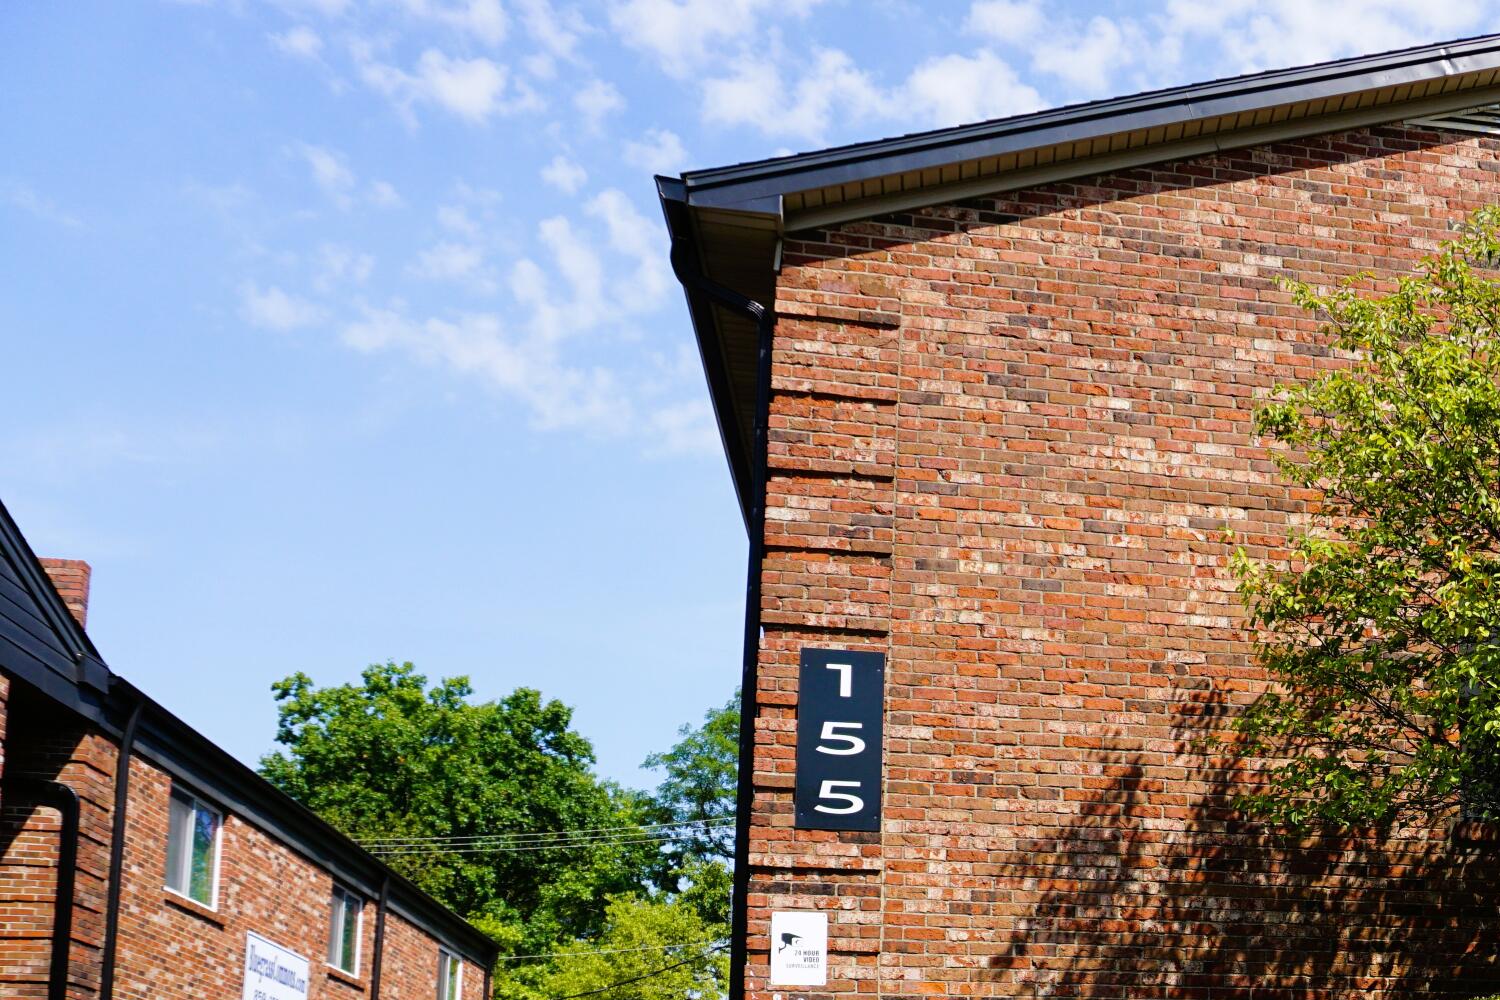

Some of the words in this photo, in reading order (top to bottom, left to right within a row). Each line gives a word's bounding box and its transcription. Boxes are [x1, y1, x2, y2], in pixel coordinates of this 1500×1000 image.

[814, 663, 866, 815] 155
[794, 949, 802, 957] 24
[803, 949, 820, 957] HOUR
